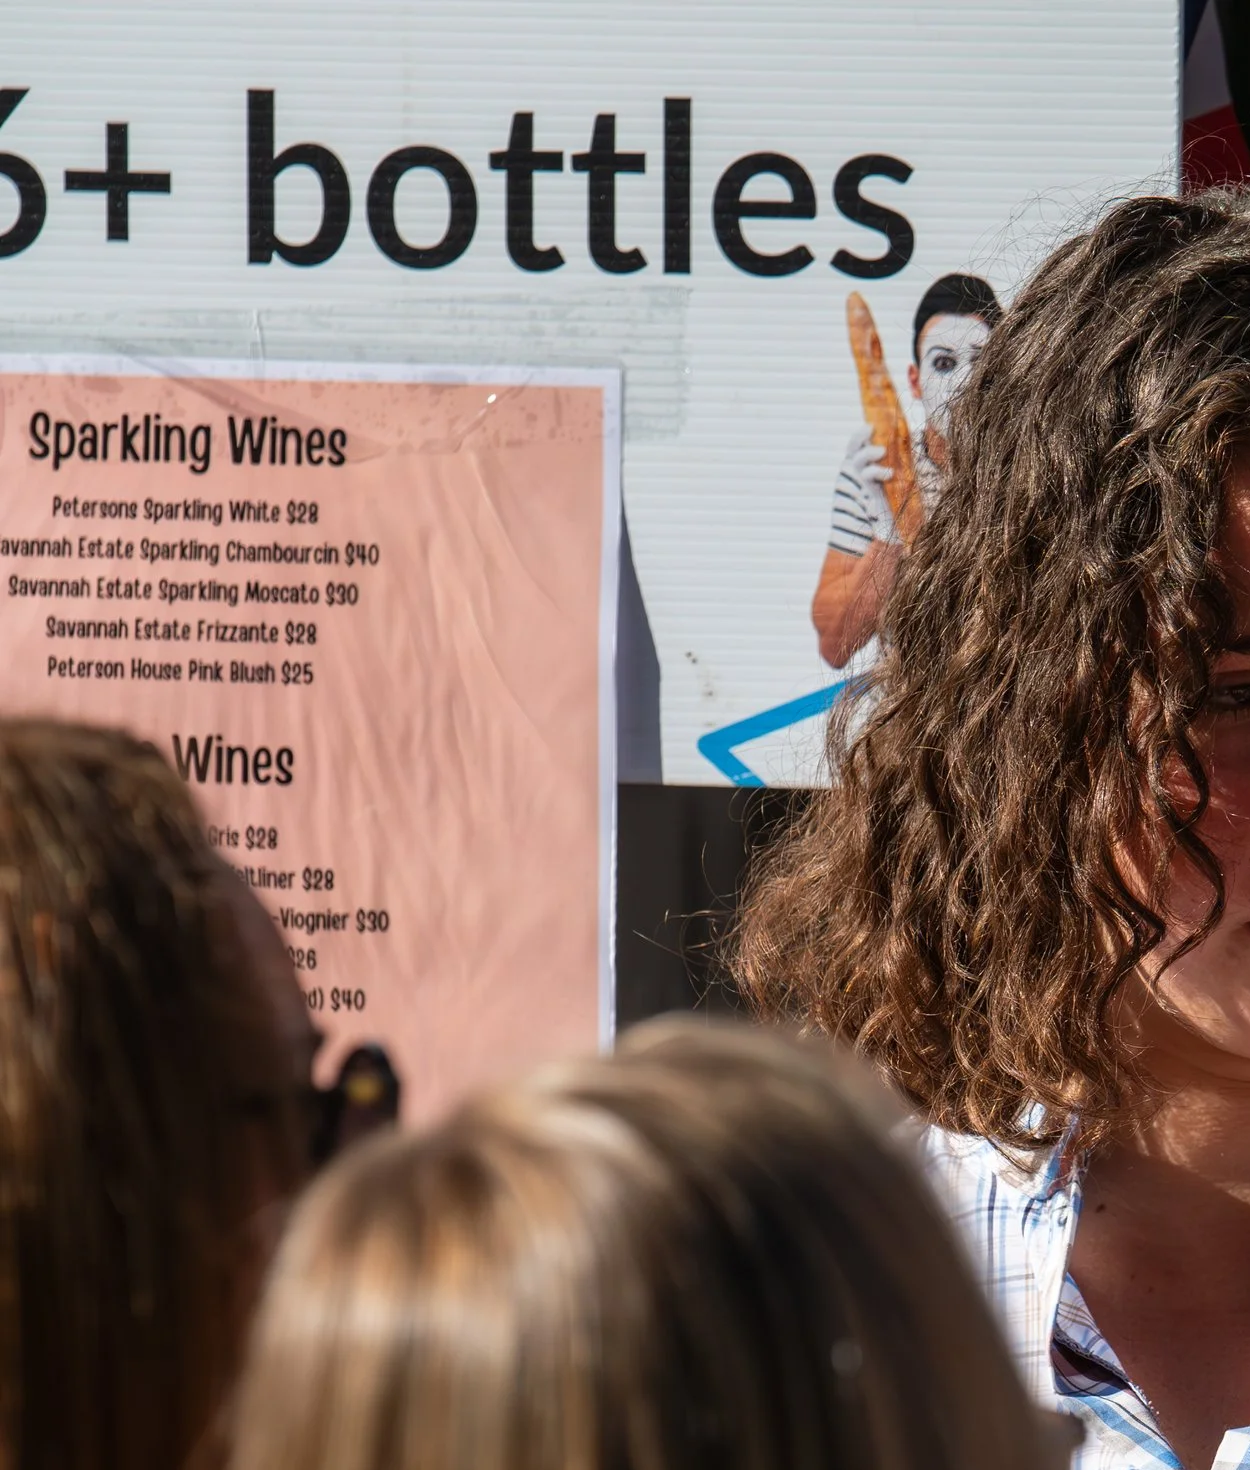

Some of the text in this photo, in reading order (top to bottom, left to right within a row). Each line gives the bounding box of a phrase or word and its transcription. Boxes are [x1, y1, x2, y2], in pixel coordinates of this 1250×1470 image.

[247, 89, 916, 280] bottles
[28, 410, 348, 476] Sparkling Wines
[52, 494, 319, 526] Petersons Sparkling White $28
[0, 535, 380, 568] avannah Estate Sparkling Chambourcin $40
[7, 573, 360, 607] Savannah Estate Sparkling Moscato $30
[45, 615, 318, 646] Savannah Estate Frizzante $28
[47, 655, 315, 686] Peterson House Pink Blush $25
[171, 733, 295, 787] Wines
[208, 825, 279, 850] Gris $28
[231, 865, 335, 892] ltliner $28
[355, 908, 390, 934] $30
[330, 987, 366, 1012] $40
